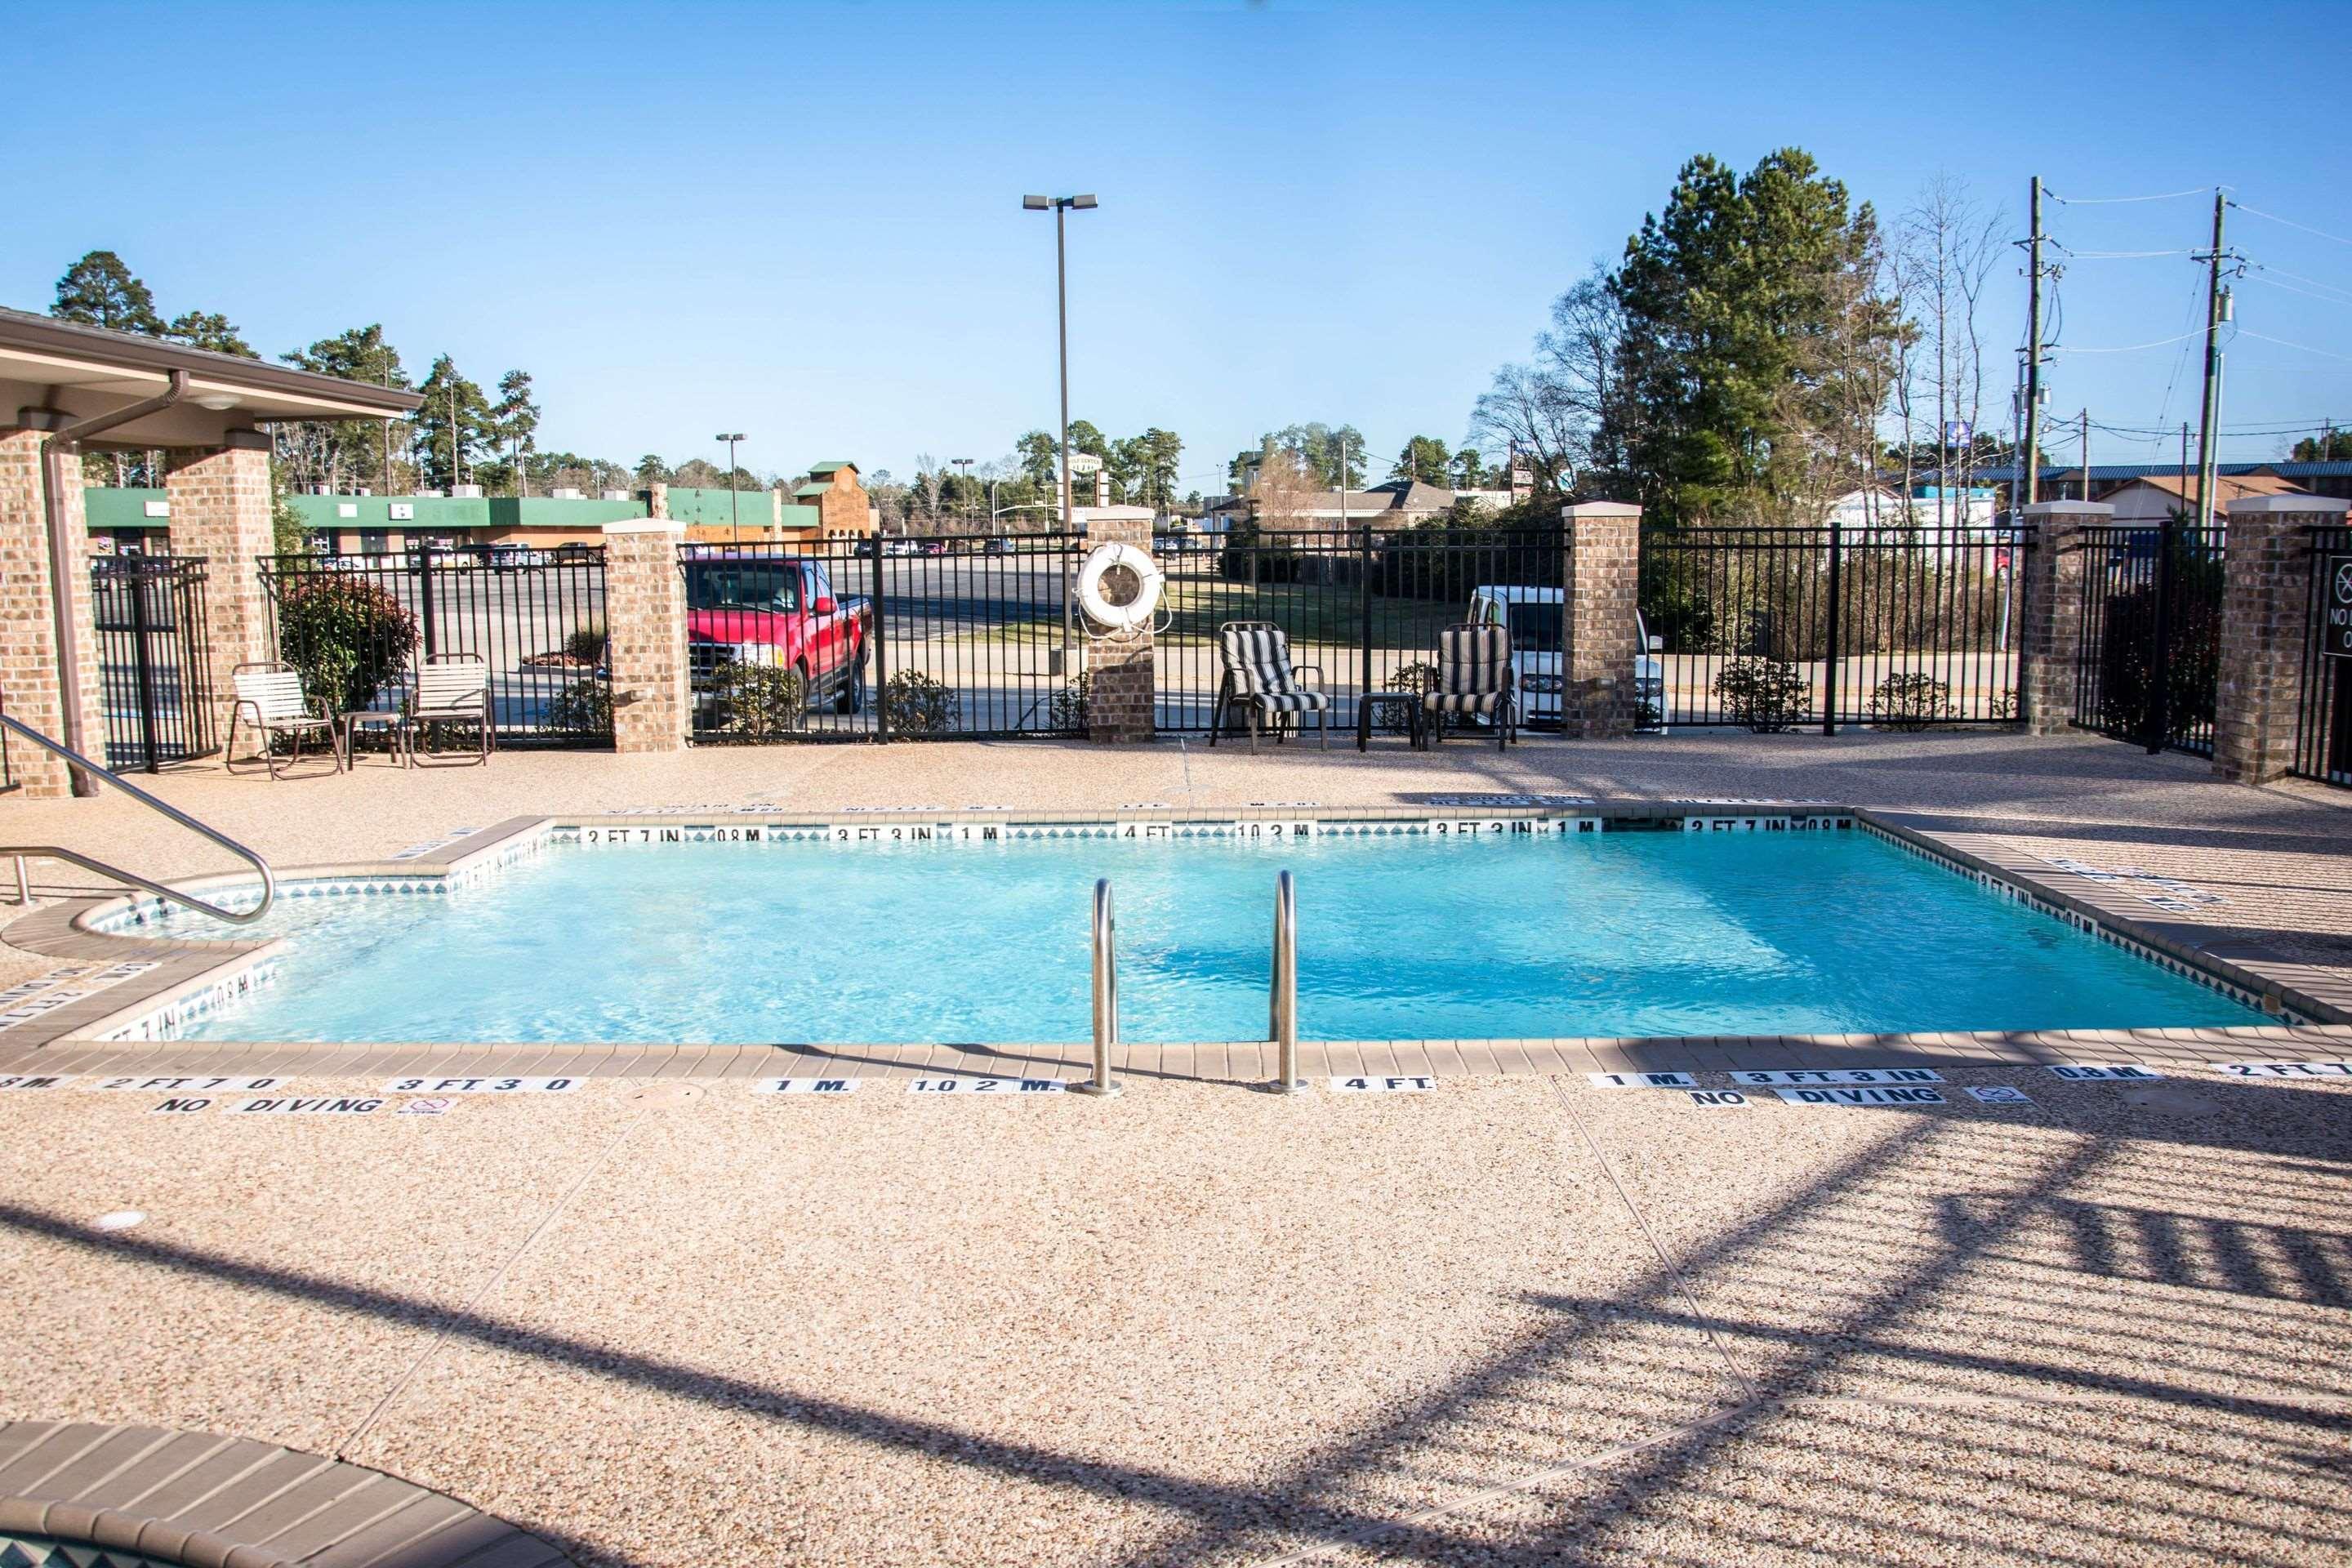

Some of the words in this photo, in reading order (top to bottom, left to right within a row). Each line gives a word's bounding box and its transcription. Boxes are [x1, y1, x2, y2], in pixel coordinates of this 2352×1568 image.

[2330, 608, 2347, 626] NO
[1146, 825, 1169, 837] FT
[1511, 822, 1532, 833] IN
[608, 830, 630, 842] FT
[660, 829, 679, 842] IN
[911, 827, 931, 840] IN
[2227, 1065, 2261, 1076] 2
[1605, 1075, 1626, 1085] 1
[1750, 1071, 1773, 1083] 3
[1848, 1071, 1873, 1083] 3
[104, 1078, 134, 1089] 2
[397, 1079, 424, 1090] 3
[776, 1080, 792, 1091] 1
[1344, 1078, 1369, 1089] 4
[1690, 1091, 1746, 1106] NO
[1796, 1087, 1943, 1102] DIVING
[154, 1098, 211, 1112] NO
[243, 1098, 384, 1113] DIVING
